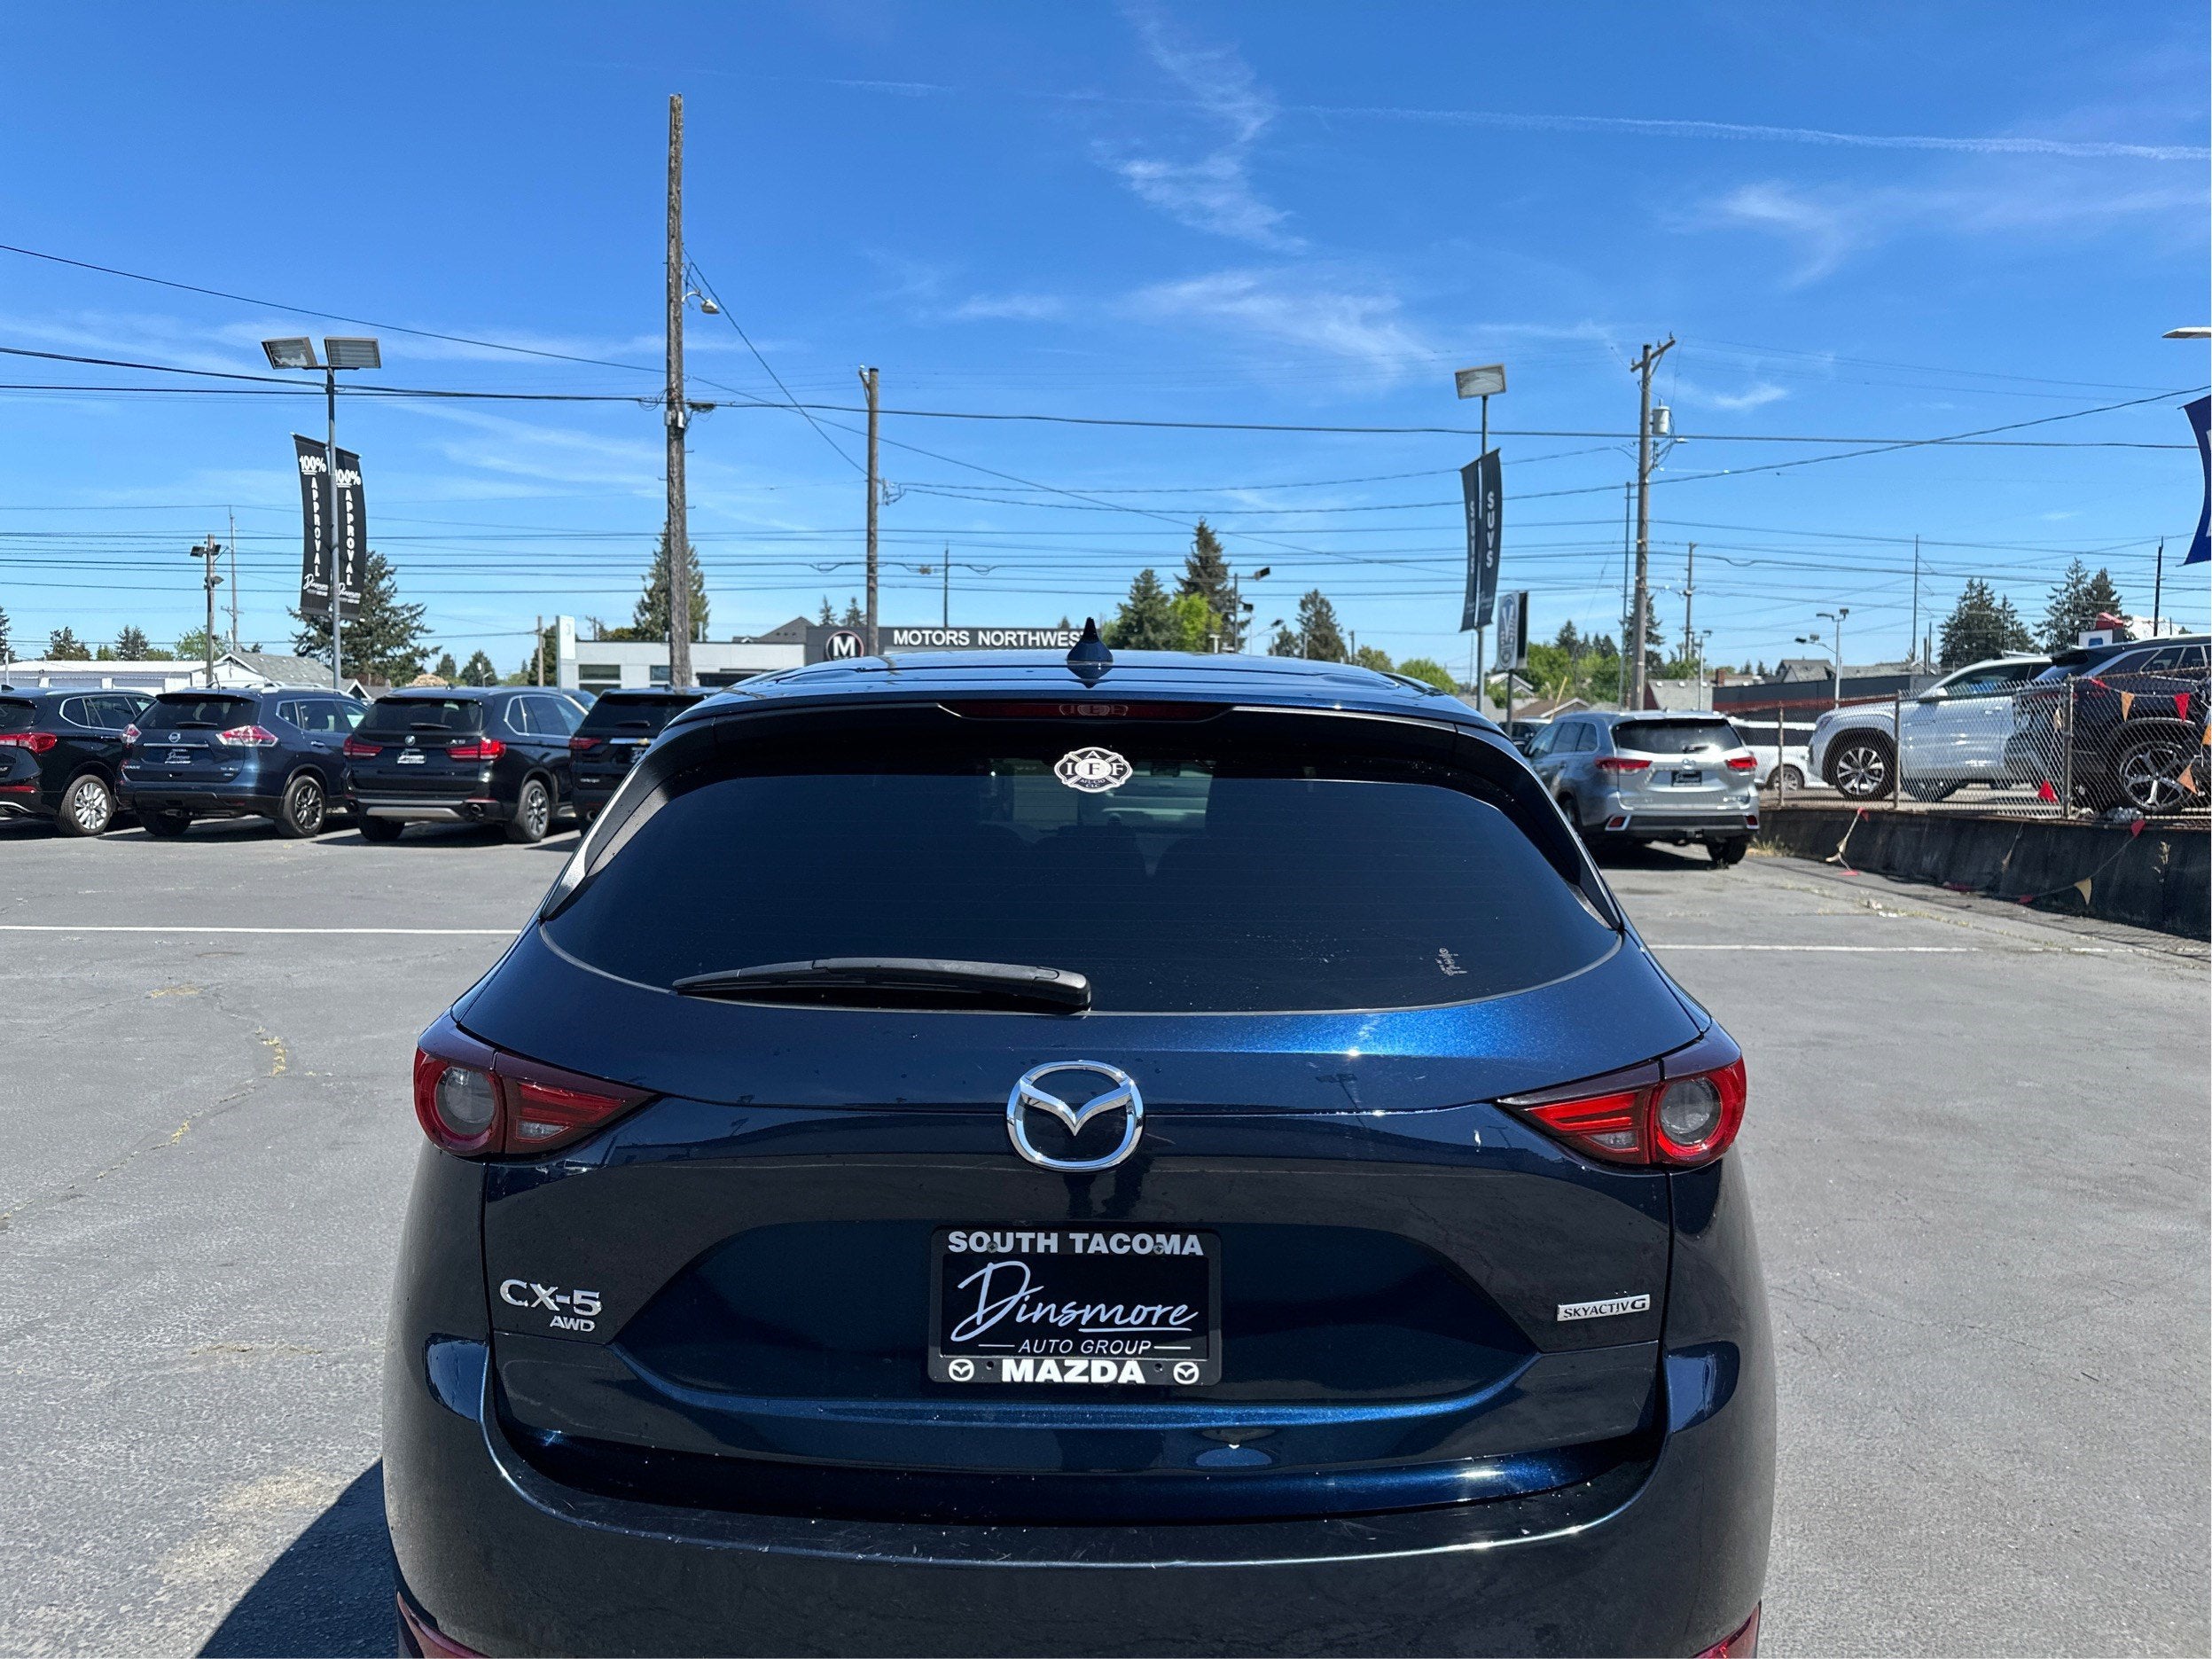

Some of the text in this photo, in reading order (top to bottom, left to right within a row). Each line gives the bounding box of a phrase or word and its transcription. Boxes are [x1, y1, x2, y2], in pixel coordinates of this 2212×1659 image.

[299, 455, 326, 473] 100%
[335, 469, 362, 486] 100%
[311, 476, 321, 577] APPROVAL
[345, 489, 355, 586] APPROVAL
[1486, 490, 1496, 568] SUVS
[833, 635, 856, 657] M
[894, 630, 1083, 647] MOTORS NORTHWES
[948, 1231, 1204, 1256] SOUTH TACOMA
[499, 1279, 603, 1317] CX-5
[950, 1260, 1199, 1342] Dinsmore
[549, 1315, 596, 1333] AWD
[1018, 1339, 1152, 1355] AUTO GROUP
[1001, 1358, 1146, 1384] MAZDA
